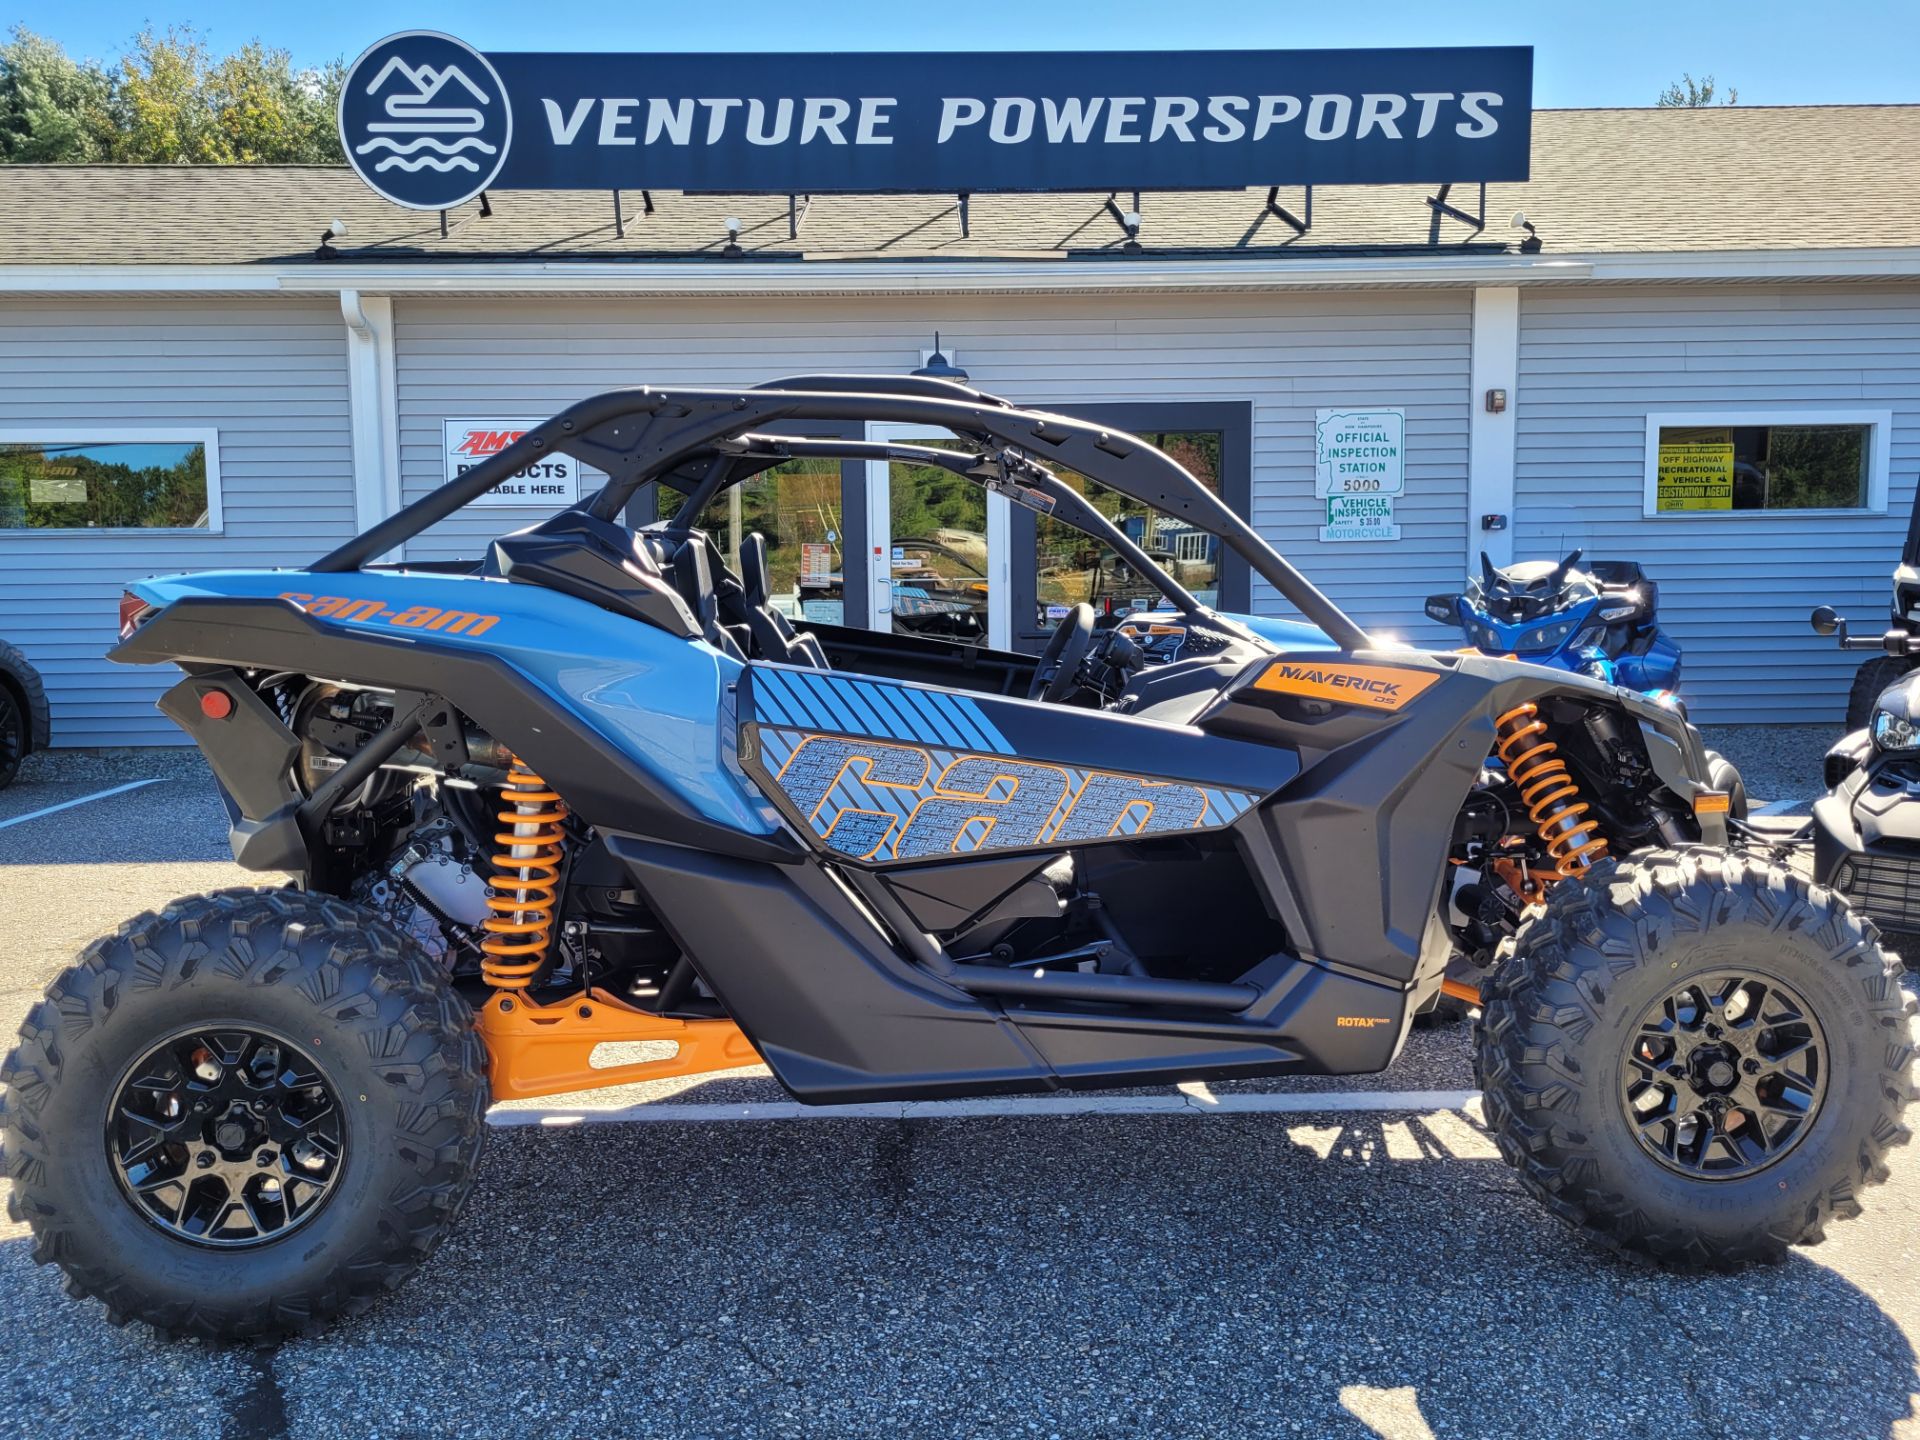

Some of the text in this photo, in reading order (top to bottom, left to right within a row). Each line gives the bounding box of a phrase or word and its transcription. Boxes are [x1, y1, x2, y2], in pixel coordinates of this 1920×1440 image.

[541, 92, 1504, 146] VENTURE POWERSPORTS
[1335, 433, 1390, 443] OFFICIAL
[1328, 447, 1397, 458] INSPECTION
[1339, 463, 1386, 473] STATION
[531, 486, 565, 494] HERE
[1343, 480, 1380, 492] 5000
[1659, 486, 1730, 497] EGISTRATION AGENT
[1341, 498, 1386, 507] VEHICLE
[1335, 508, 1390, 517] INSPECTION
[1327, 527, 1392, 538] MOTORCYCLE
[1279, 665, 1402, 696] MAVERICK
[1373, 696, 1396, 705] DS
[1337, 1016, 1374, 1027] ROTAX
